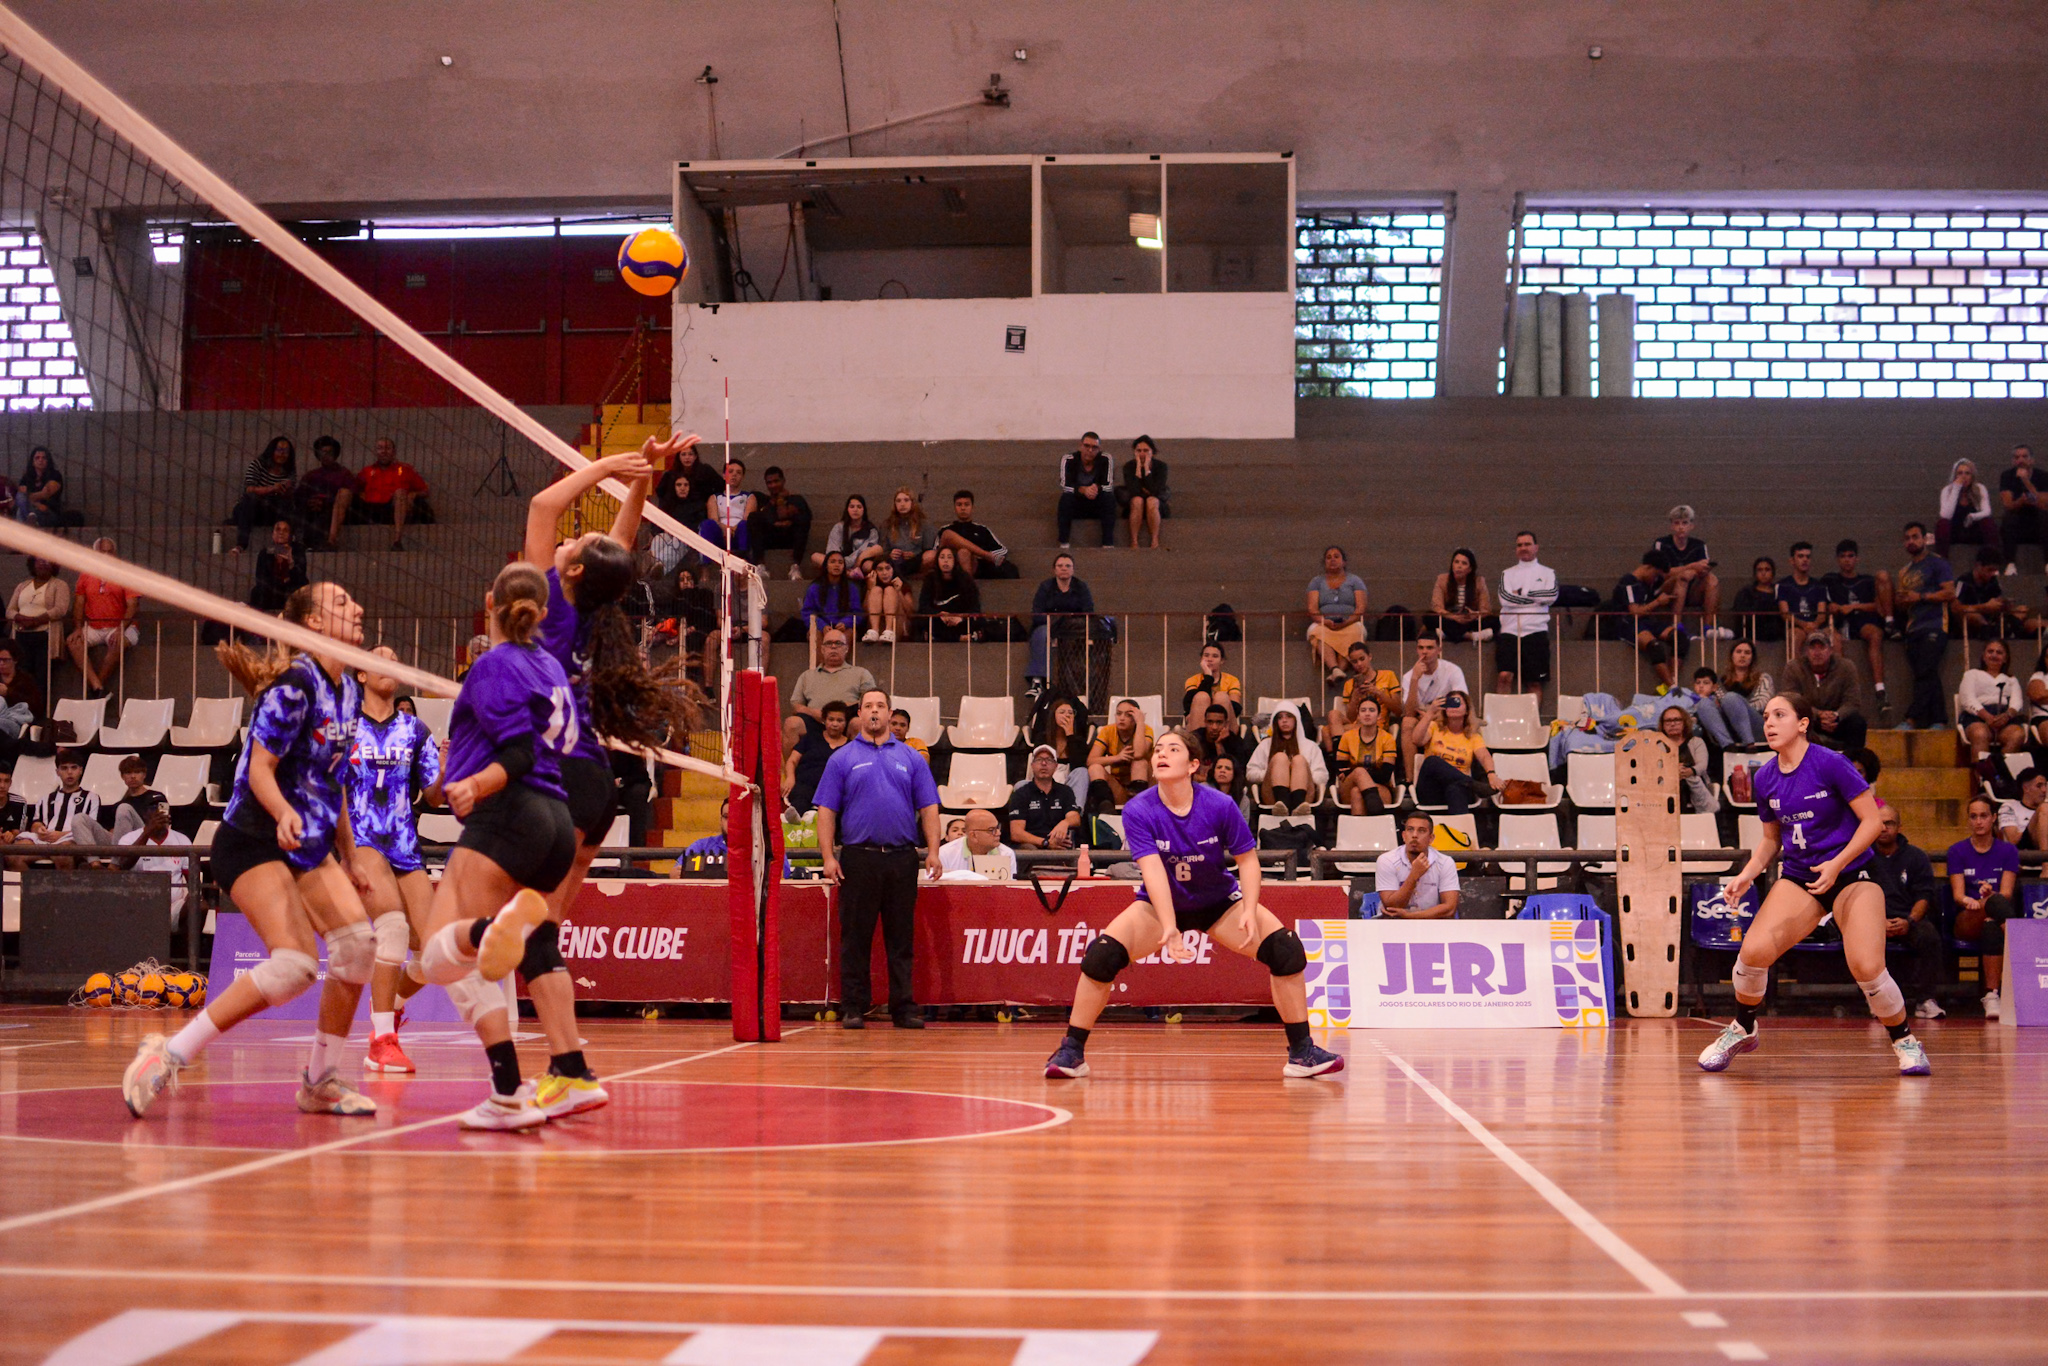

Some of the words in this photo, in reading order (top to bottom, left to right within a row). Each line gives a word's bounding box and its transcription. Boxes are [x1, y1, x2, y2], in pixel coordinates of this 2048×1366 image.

[328, 752, 343, 773] 7
[361, 745, 413, 762] ELITE
[376, 769, 386, 788] 1
[1791, 823, 1807, 850] 4
[691, 855, 702, 872] 1
[1175, 862, 1192, 882] 6
[558, 919, 610, 959] ÊNIS
[612, 926, 689, 960] CLUBE
[962, 928, 1048, 964] TIJUCA
[234, 950, 261, 959] Parceria
[1378, 941, 1527, 997] JERJ
[1378, 1000, 1404, 1008] JOGOS
[1404, 1000, 1446, 1008] ESCOLARES
[1447, 1000, 1458, 1008] DO
[1459, 1000, 1472, 1008] RIO
[1473, 1000, 1482, 1008] DE
[1484, 1000, 1515, 1008] JANEIRO
[1515, 1000, 1532, 1008] 2025
